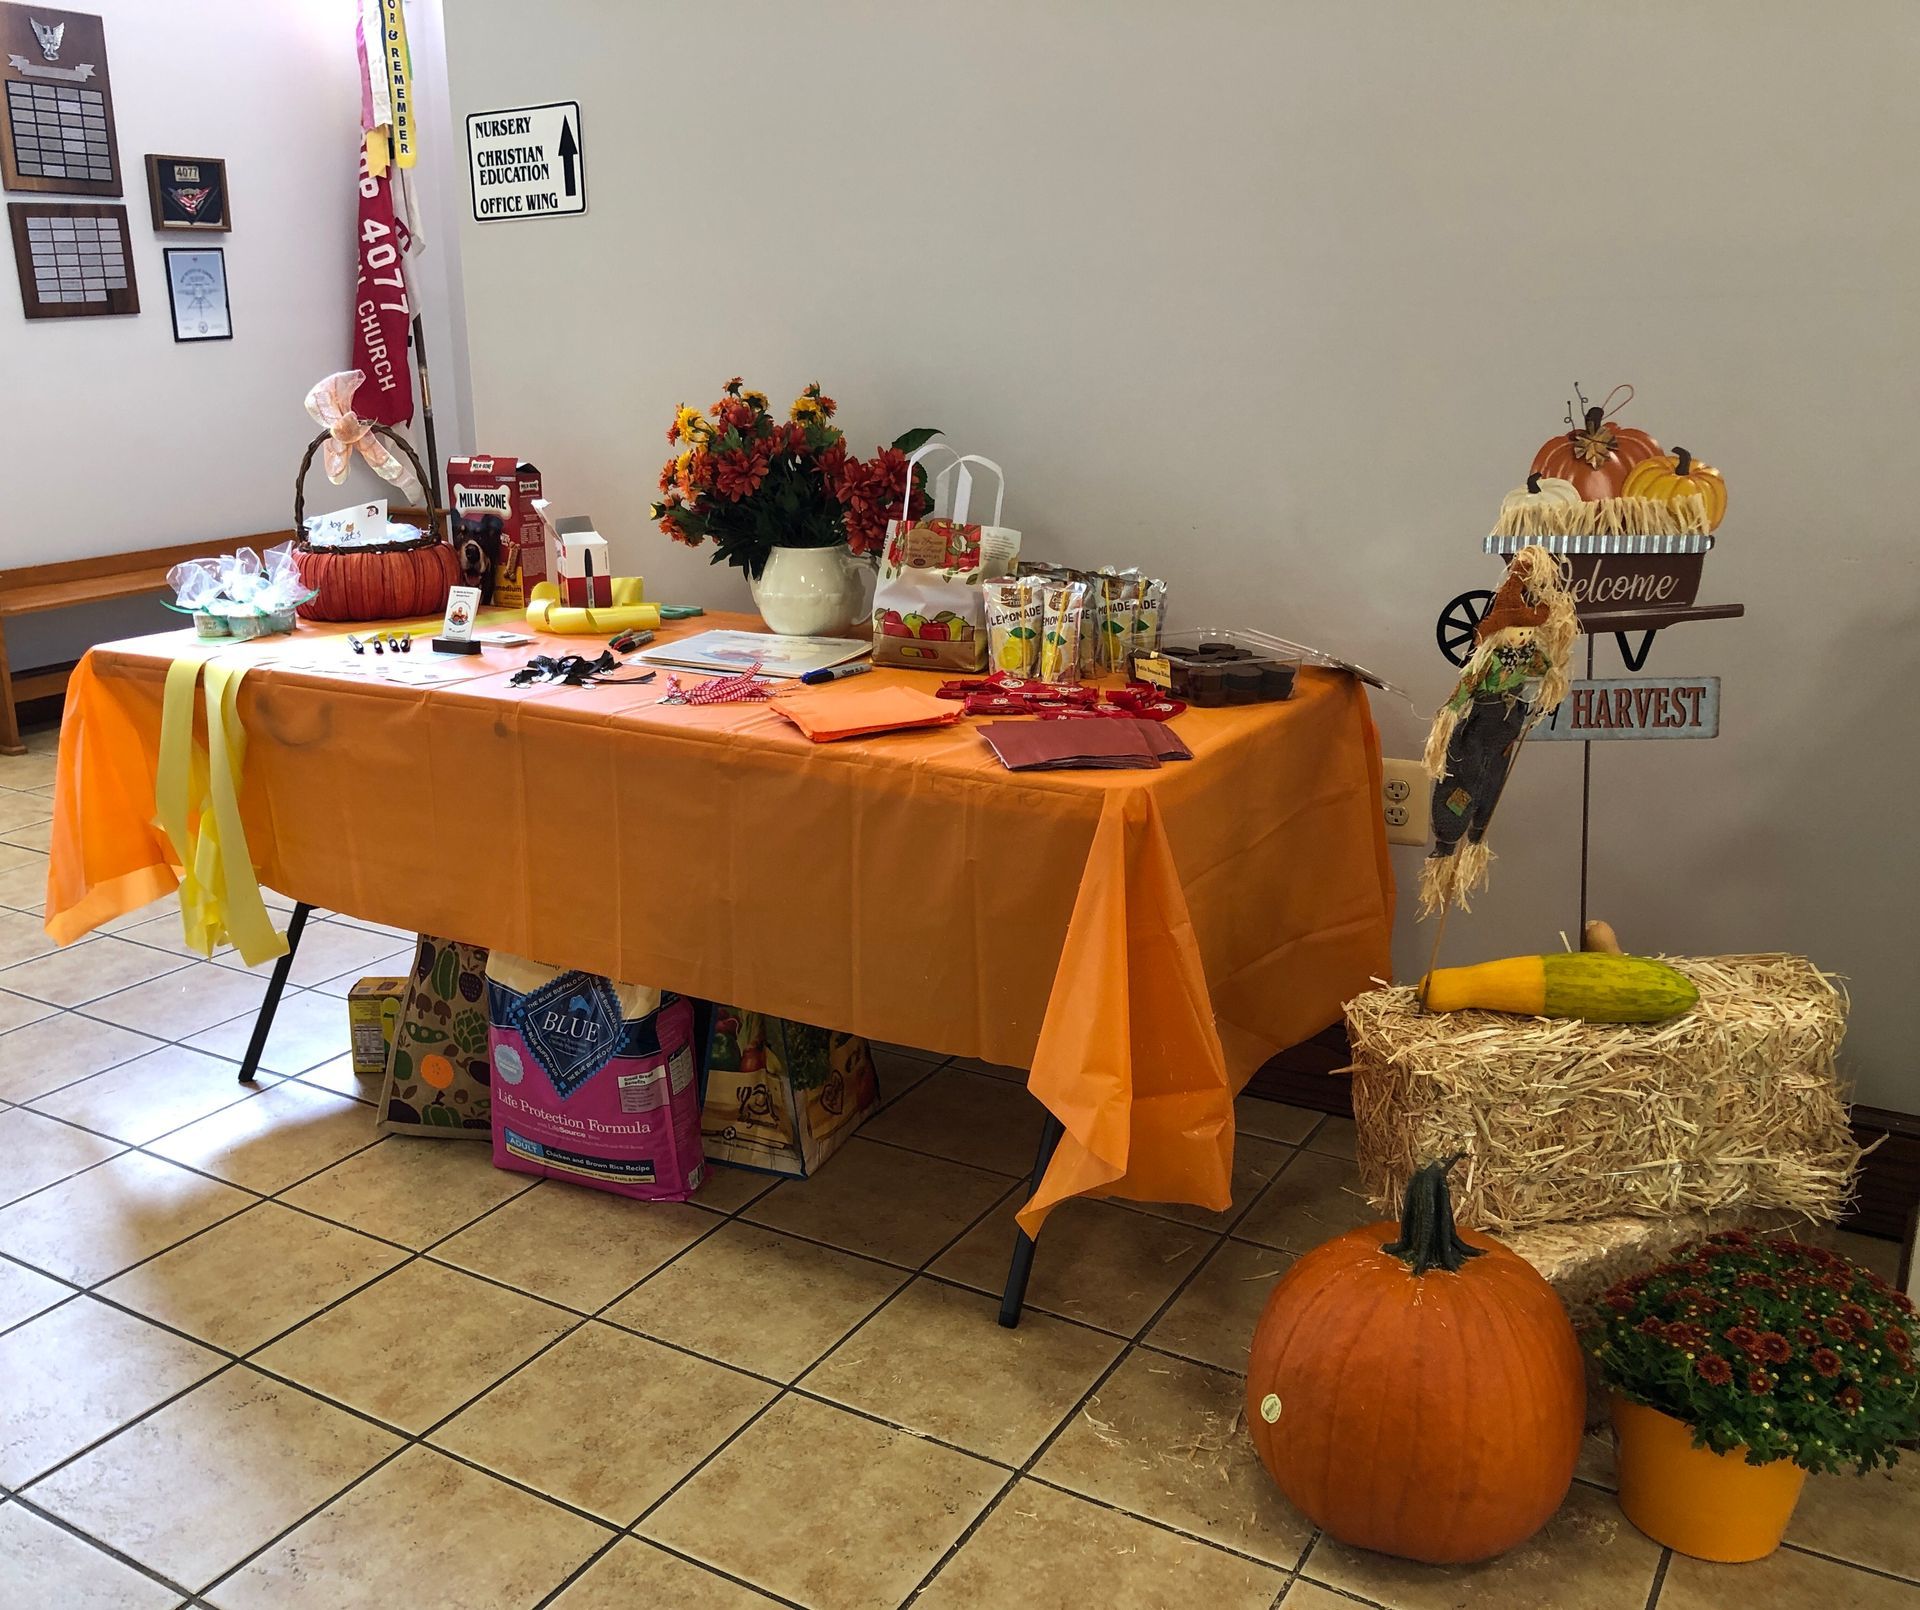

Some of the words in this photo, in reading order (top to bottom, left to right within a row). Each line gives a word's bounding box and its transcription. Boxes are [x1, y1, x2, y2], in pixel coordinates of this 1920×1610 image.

[388, 30, 398, 40] &
[391, 47, 409, 154] REMEMBER
[475, 116, 531, 139] NURSERY
[477, 145, 544, 168] CHRISTIAN
[176, 167, 198, 177] 4077
[480, 163, 550, 186] EDUCATION
[480, 195, 523, 214] OFFICE
[525, 192, 559, 211] WING
[361, 218, 410, 315] 4077
[358, 299, 397, 392] CHURCH
[1570, 686, 1707, 729] HARVEST
[542, 1011, 600, 1042] BLUE
[497, 1087, 518, 1109] Life
[519, 1098, 588, 1130] Protection
[587, 1117, 651, 1135] Formula
[508, 1137, 538, 1154] ADULT
[545, 1149, 571, 1162] Chicken
[572, 1157, 584, 1165] and
[585, 1159, 608, 1170] Brown
[609, 1163, 624, 1171] Rice
[625, 1164, 650, 1173] Recipe
